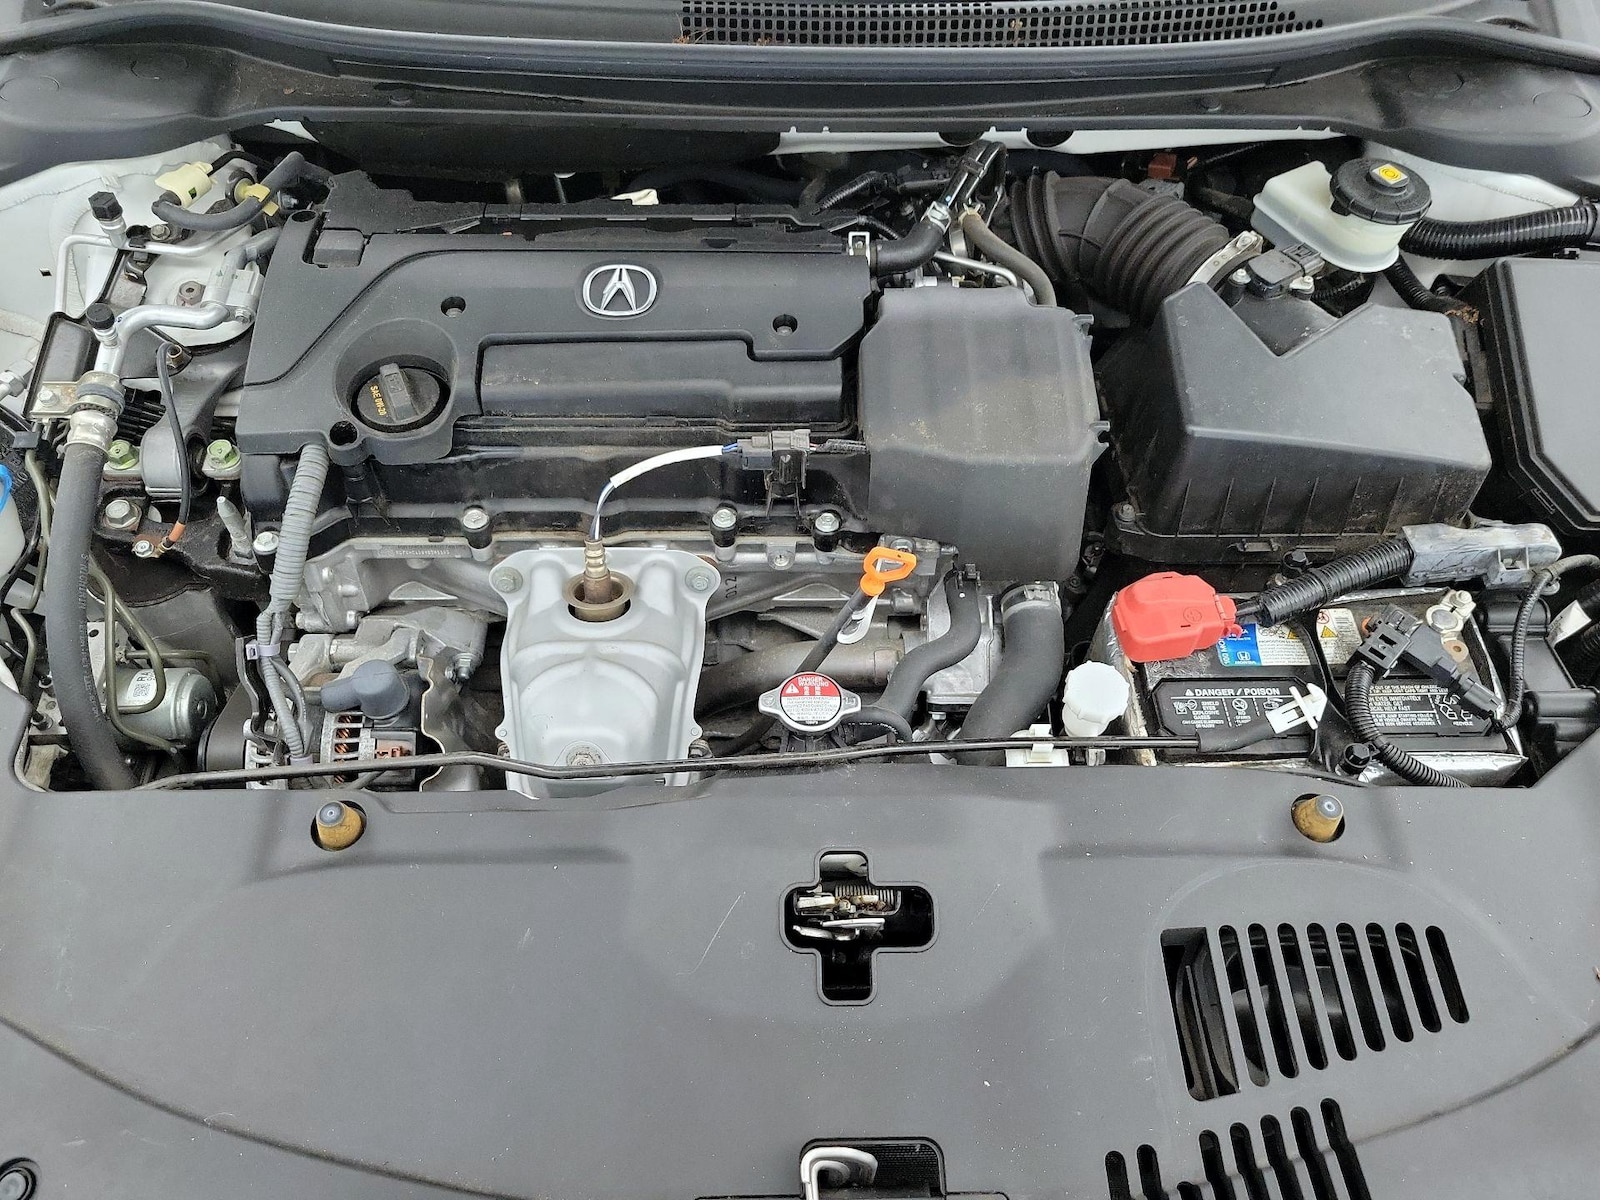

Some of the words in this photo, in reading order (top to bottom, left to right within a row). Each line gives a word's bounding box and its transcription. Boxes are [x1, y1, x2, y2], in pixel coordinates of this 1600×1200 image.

[370, 385, 381, 398] SAE
[1194, 688, 1235, 697] DANGER
[1244, 687, 1280, 696] POISON
